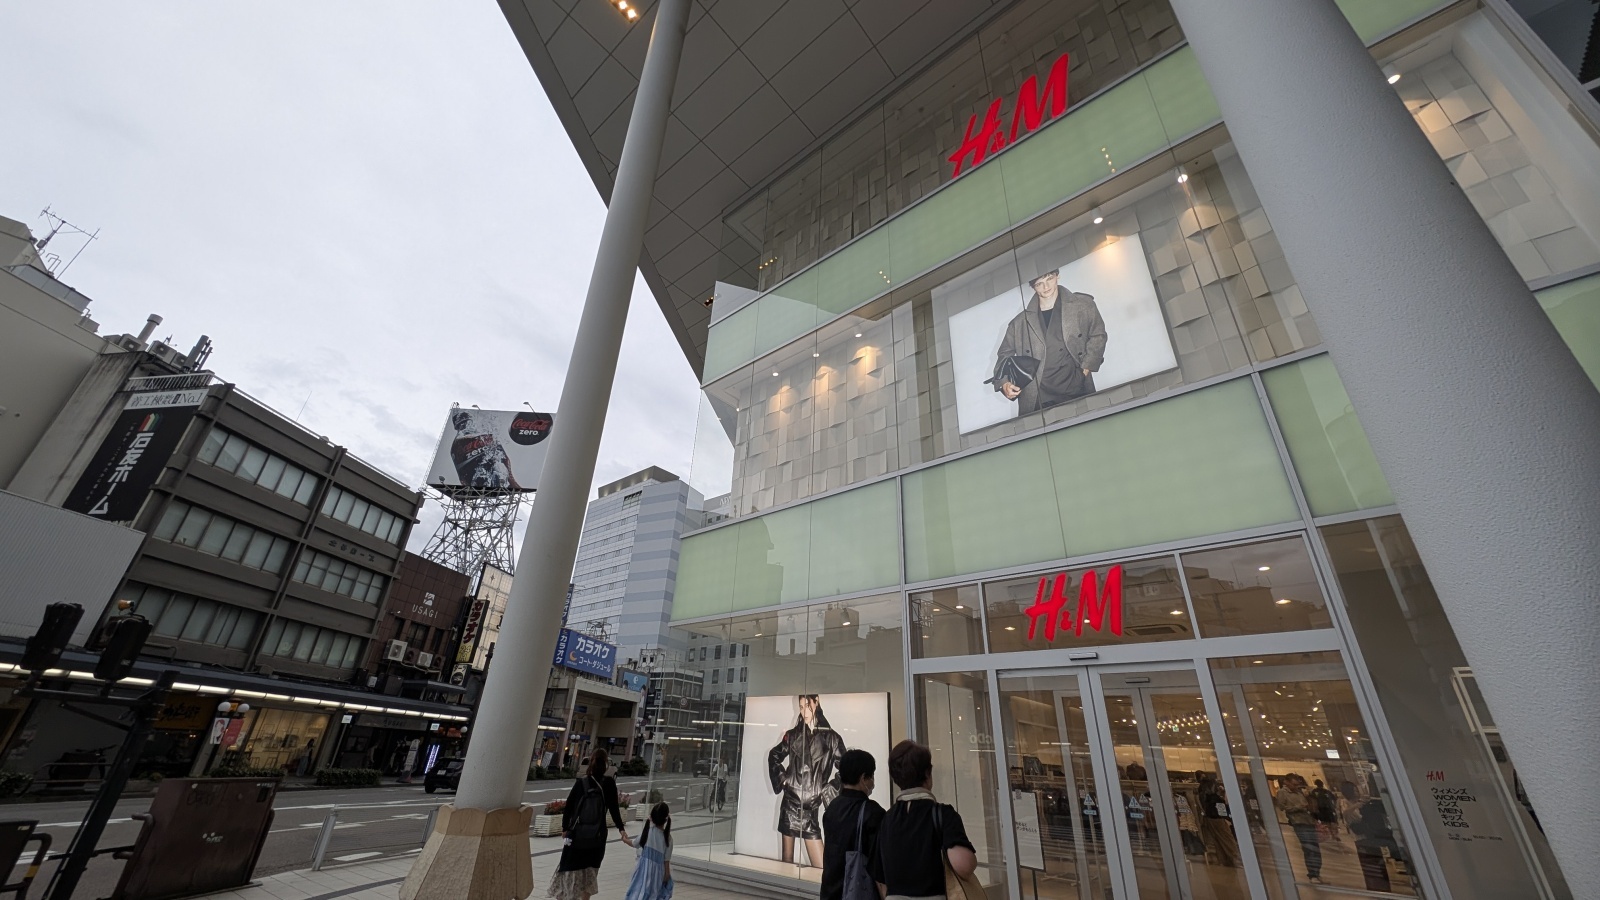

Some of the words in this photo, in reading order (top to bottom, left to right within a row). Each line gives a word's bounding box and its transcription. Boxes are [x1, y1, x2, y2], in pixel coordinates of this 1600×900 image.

[948, 53, 1069, 178] H&M
[87, 432, 154, 515] 石友ホーム
[411, 604, 438, 619] USAGI
[1025, 565, 1122, 641] H&M
[463, 600, 484, 644] カラオケ
[555, 635, 568, 664] カラオケ
[575, 636, 610, 659] カラオケ
[1426, 770, 1445, 782] H&M
